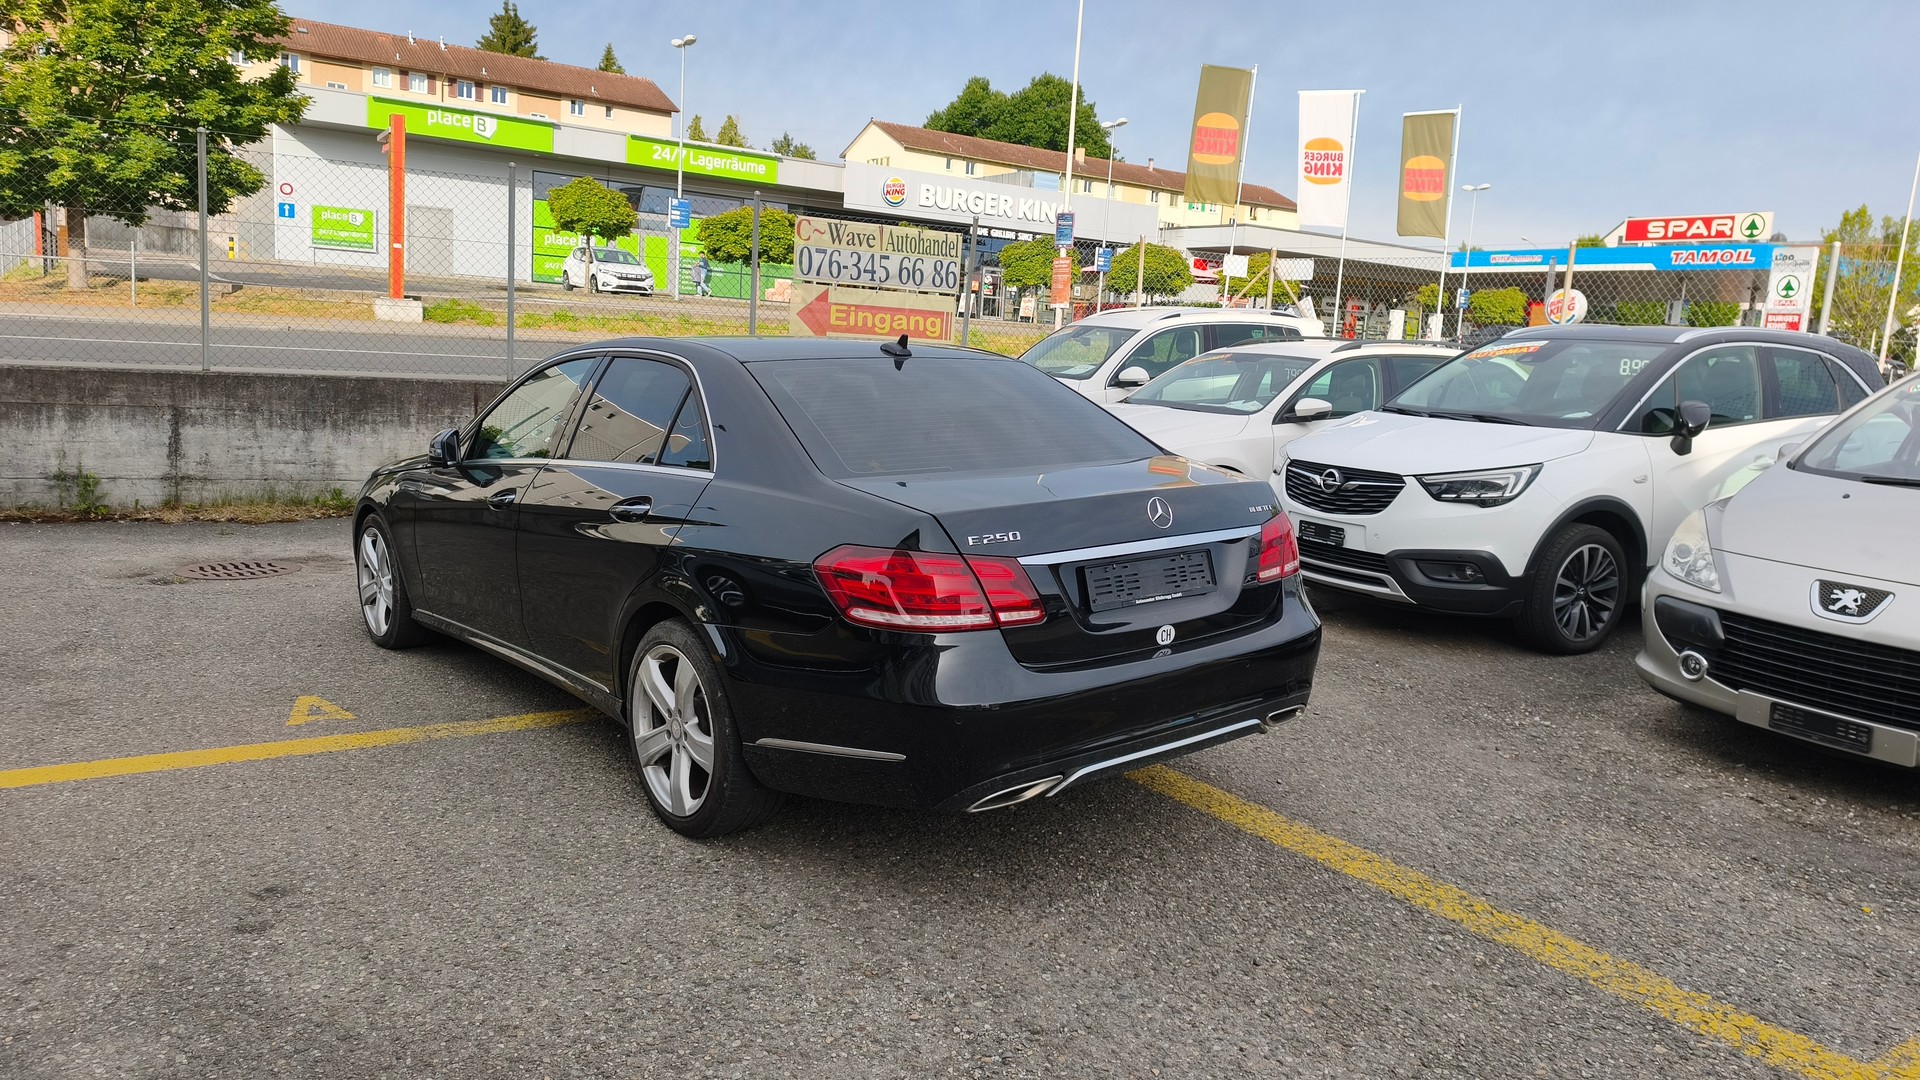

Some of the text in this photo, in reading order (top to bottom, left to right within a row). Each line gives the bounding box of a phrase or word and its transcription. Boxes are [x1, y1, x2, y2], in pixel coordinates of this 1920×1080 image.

[428, 109, 487, 132] place B
[652, 145, 766, 175] 24/7 Lagerräume
[886, 188, 905, 196] KING
[919, 183, 1013, 218] BURGER
[321, 210, 348, 220] place
[1647, 218, 1733, 238] SPAR
[544, 233, 577, 246] place
[885, 229, 959, 258] Autohandel
[1672, 249, 1755, 264] TAMOIL
[798, 246, 958, 289] 076-345 66 86
[829, 304, 942, 337] Eingang
[982, 531, 1021, 544] 250
[1161, 628, 1172, 642] CH
